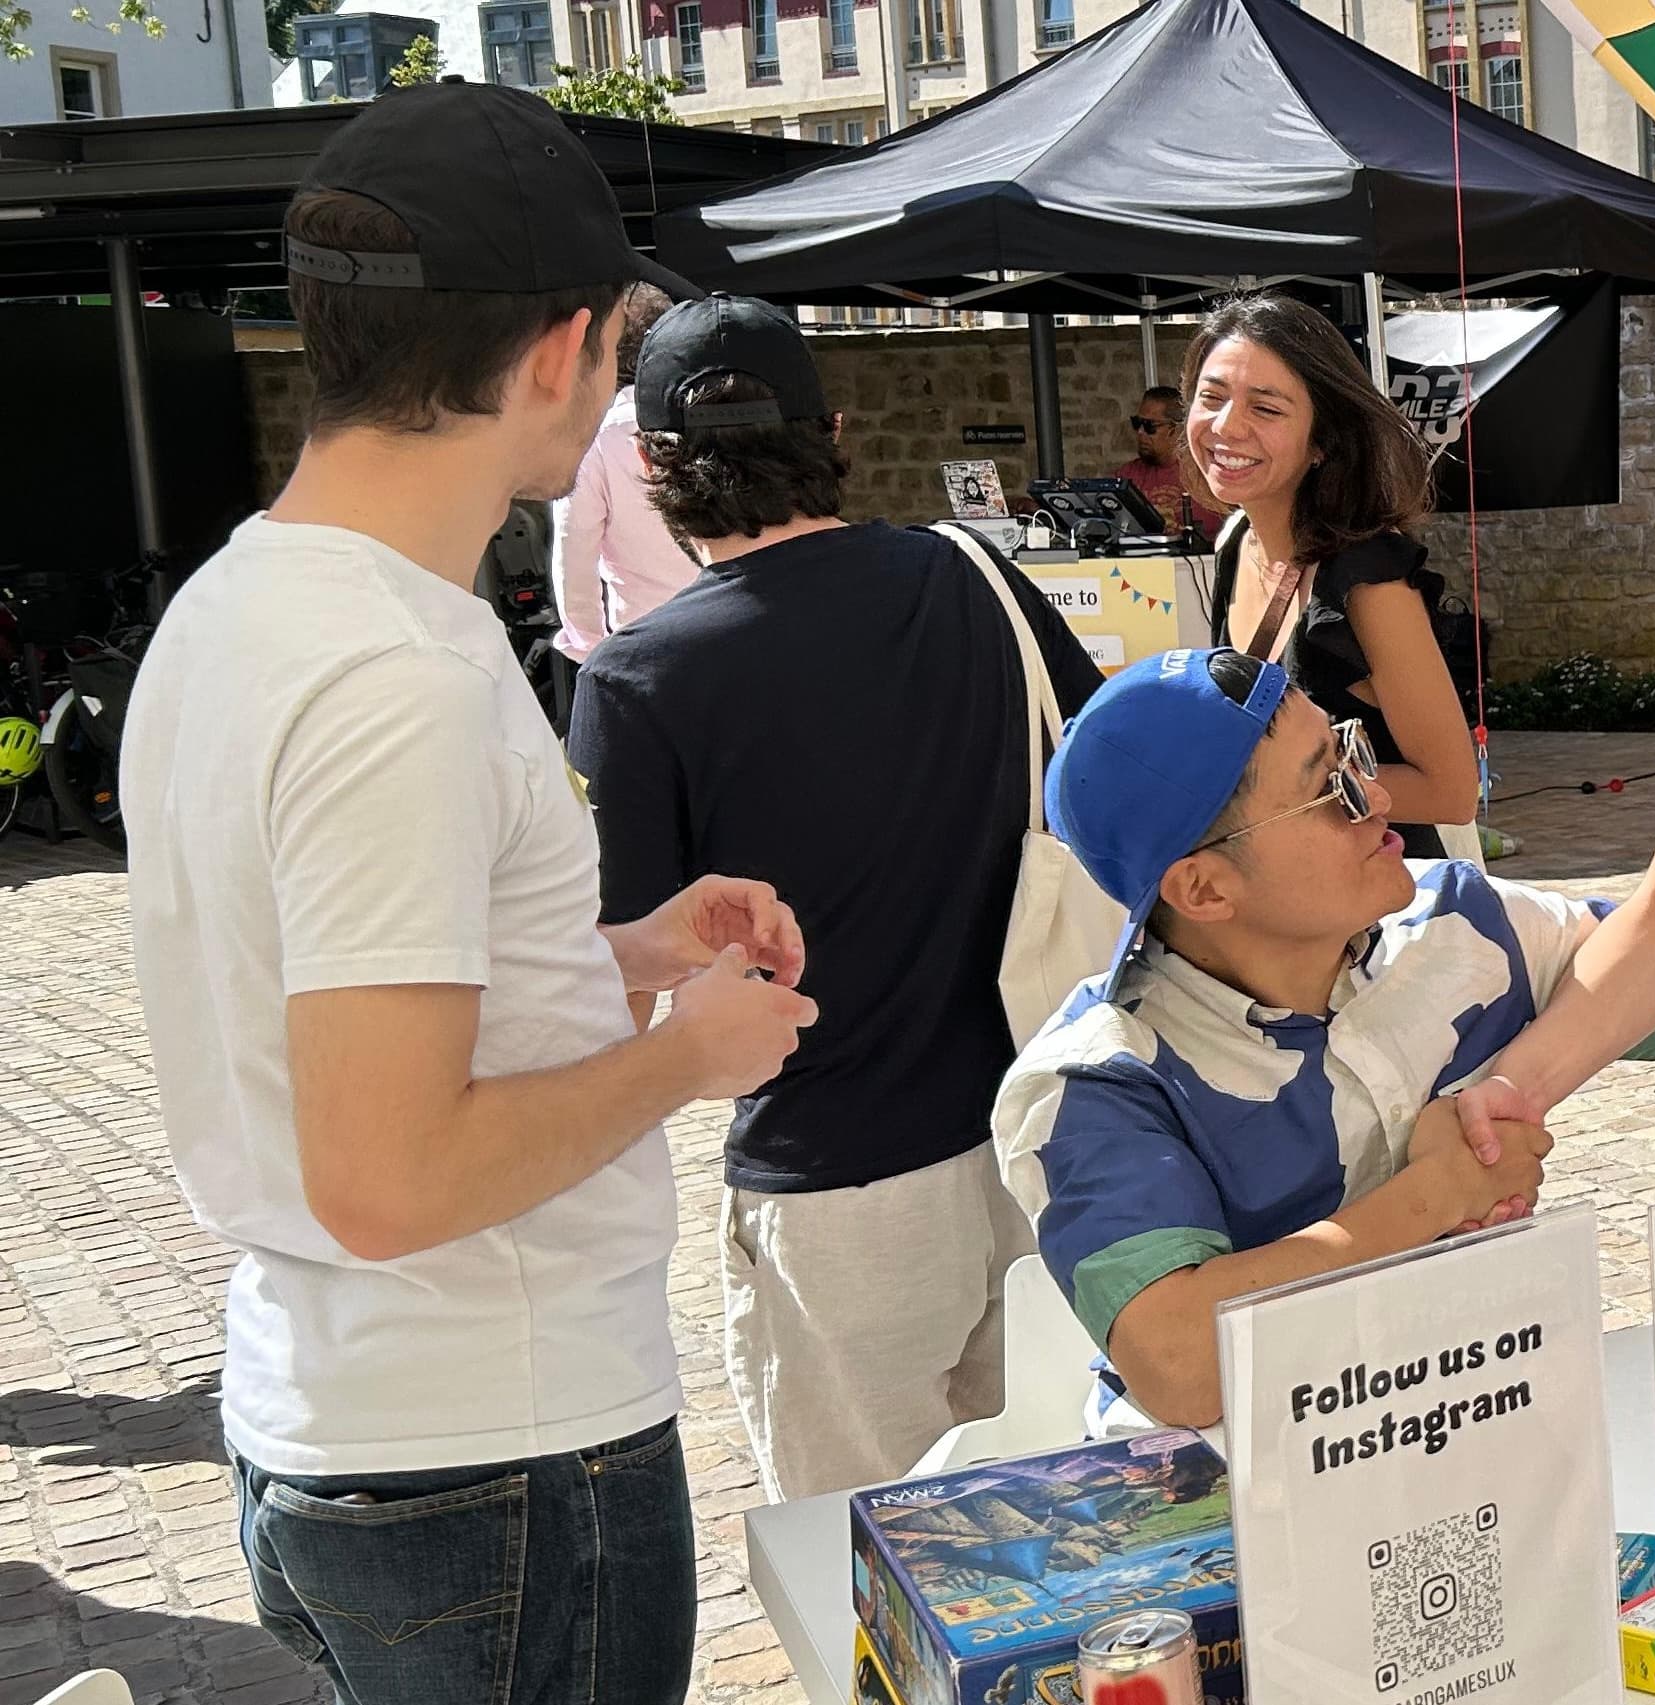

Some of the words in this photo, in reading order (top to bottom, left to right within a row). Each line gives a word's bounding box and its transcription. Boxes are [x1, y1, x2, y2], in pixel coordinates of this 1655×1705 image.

[1079, 590, 1098, 606] to
[1291, 1356, 1428, 1423] Follow
[1439, 1340, 1486, 1377] us
[1495, 1323, 1543, 1360] on
[1312, 1380, 1532, 1475] Instagram
[966, 1548, 1238, 1645] arcassonne
